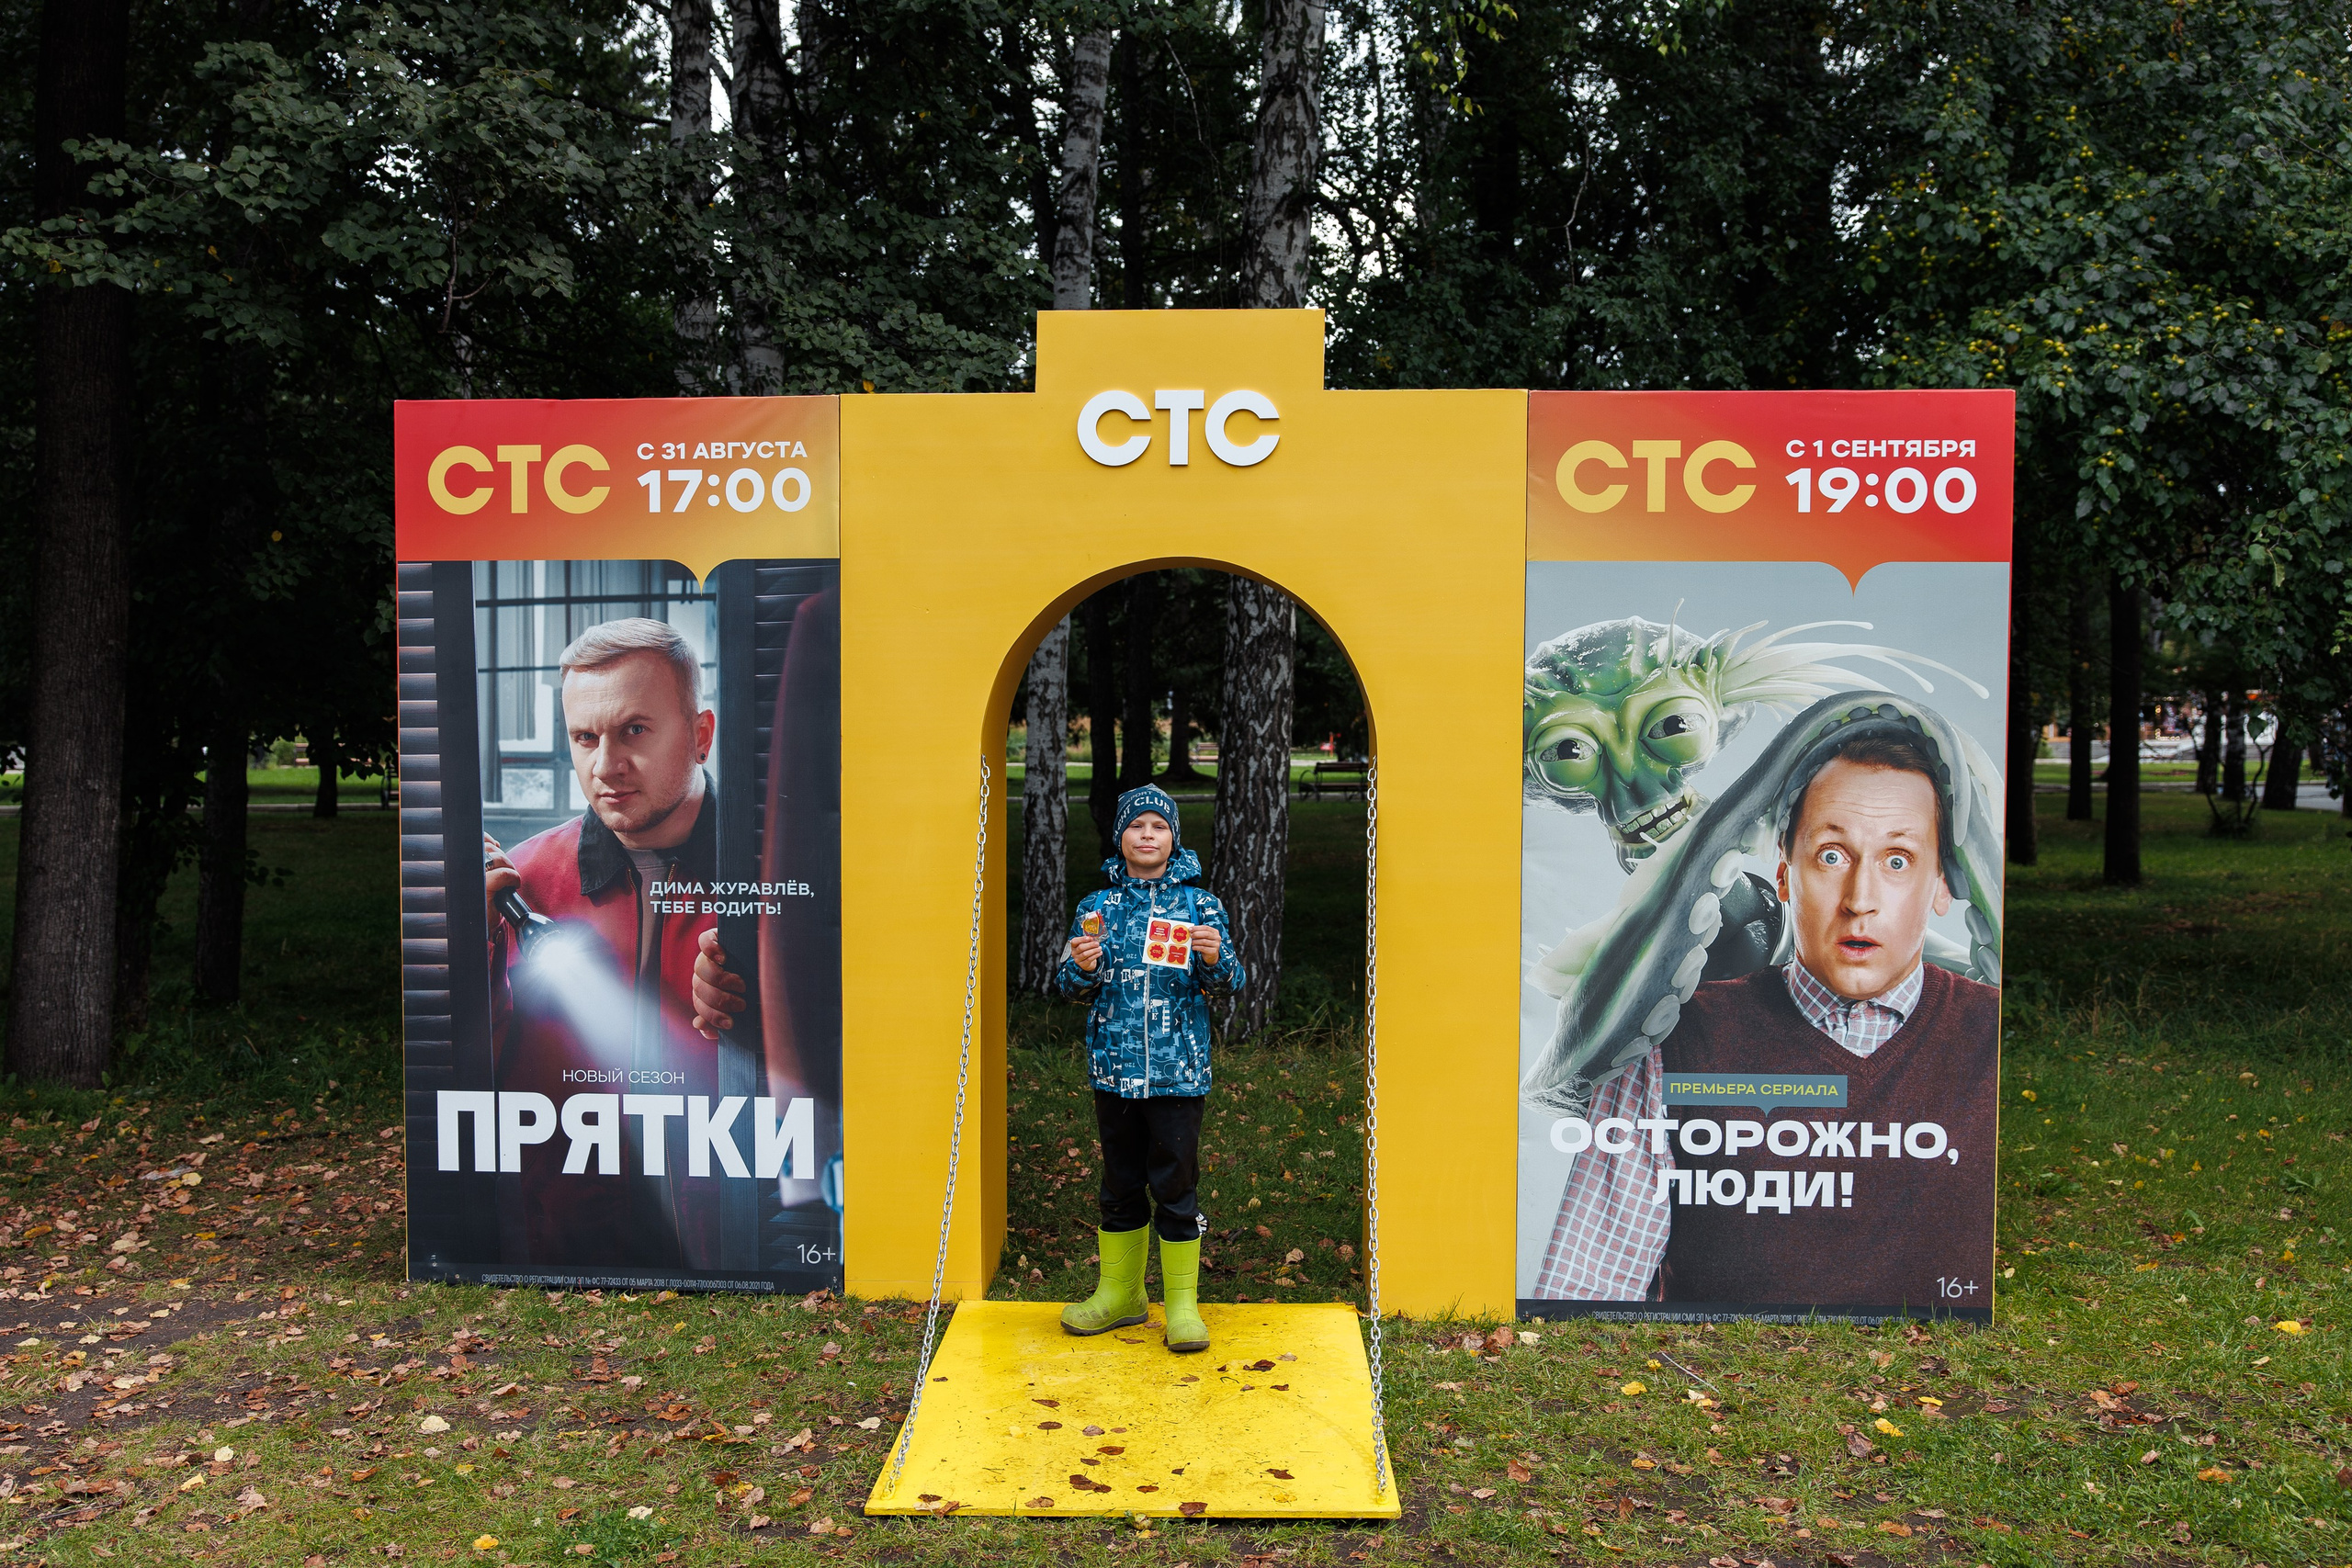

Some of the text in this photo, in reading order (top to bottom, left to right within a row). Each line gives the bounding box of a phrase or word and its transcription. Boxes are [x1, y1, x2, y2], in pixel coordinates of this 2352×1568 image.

[1077, 389, 1280, 467] СТС
[637, 441, 808, 460] С 31 АВГУСТА
[1786, 439, 1977, 457] С 1 СЕНТЯБРЯ
[428, 444, 611, 514] СТС
[1555, 440, 1757, 513] СТС
[637, 467, 811, 513] 17:00
[1785, 467, 1977, 514] 19:00
[1134, 795, 1170, 814] CLUB
[650, 879, 815, 898] ДИМА ЖУРАВЛЁВ,
[650, 900, 782, 917] ТЕБЕ ВОДИТЬ!
[562, 1067, 684, 1085] НОВЫЙ СЕЗОН
[1669, 1081, 1838, 1097] ПРЕМЬЕРА СЕРИАЛА
[436, 1090, 815, 1179] ПРЯТКИ
[1550, 1117, 1959, 1165] ОСТОРОЖНО,
[1652, 1169, 1855, 1214] ЛЮДИ!
[797, 1243, 836, 1265] 16+
[481, 1273, 523, 1282] СВИДЕТЕЛЬСТВО
[524, 1275, 528, 1283] О
[529, 1275, 562, 1284] РЕГИСТРАЦИИ
[563, 1276, 576, 1284] СМИ
[592, 1277, 600, 1285] ФС
[622, 1277, 628, 1286] ОТ
[637, 1278, 653, 1287] МАРТА
[728, 1280, 734, 1289] ОТ
[761, 1280, 775, 1291] ГОДА
[1936, 1276, 1979, 1298] 16+
[1638, 1311, 1643, 1320] О
[1682, 1312, 1695, 1322] СМИ
[1713, 1314, 1721, 1322] ФС
